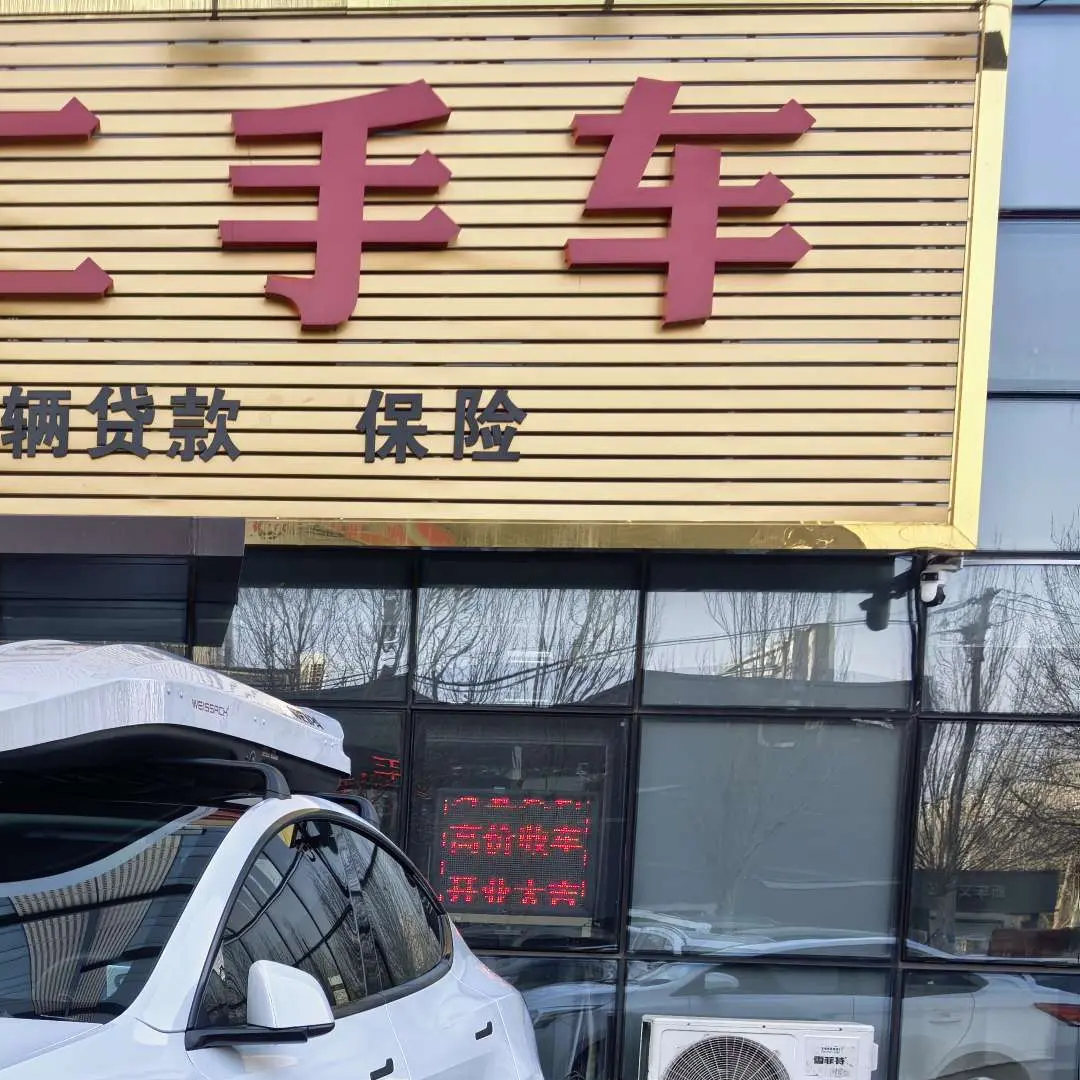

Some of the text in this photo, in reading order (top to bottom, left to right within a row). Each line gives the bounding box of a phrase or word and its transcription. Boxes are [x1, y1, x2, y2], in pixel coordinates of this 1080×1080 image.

[356, 388, 528, 463] 保险
[449, 823, 583, 856] 高价收车
